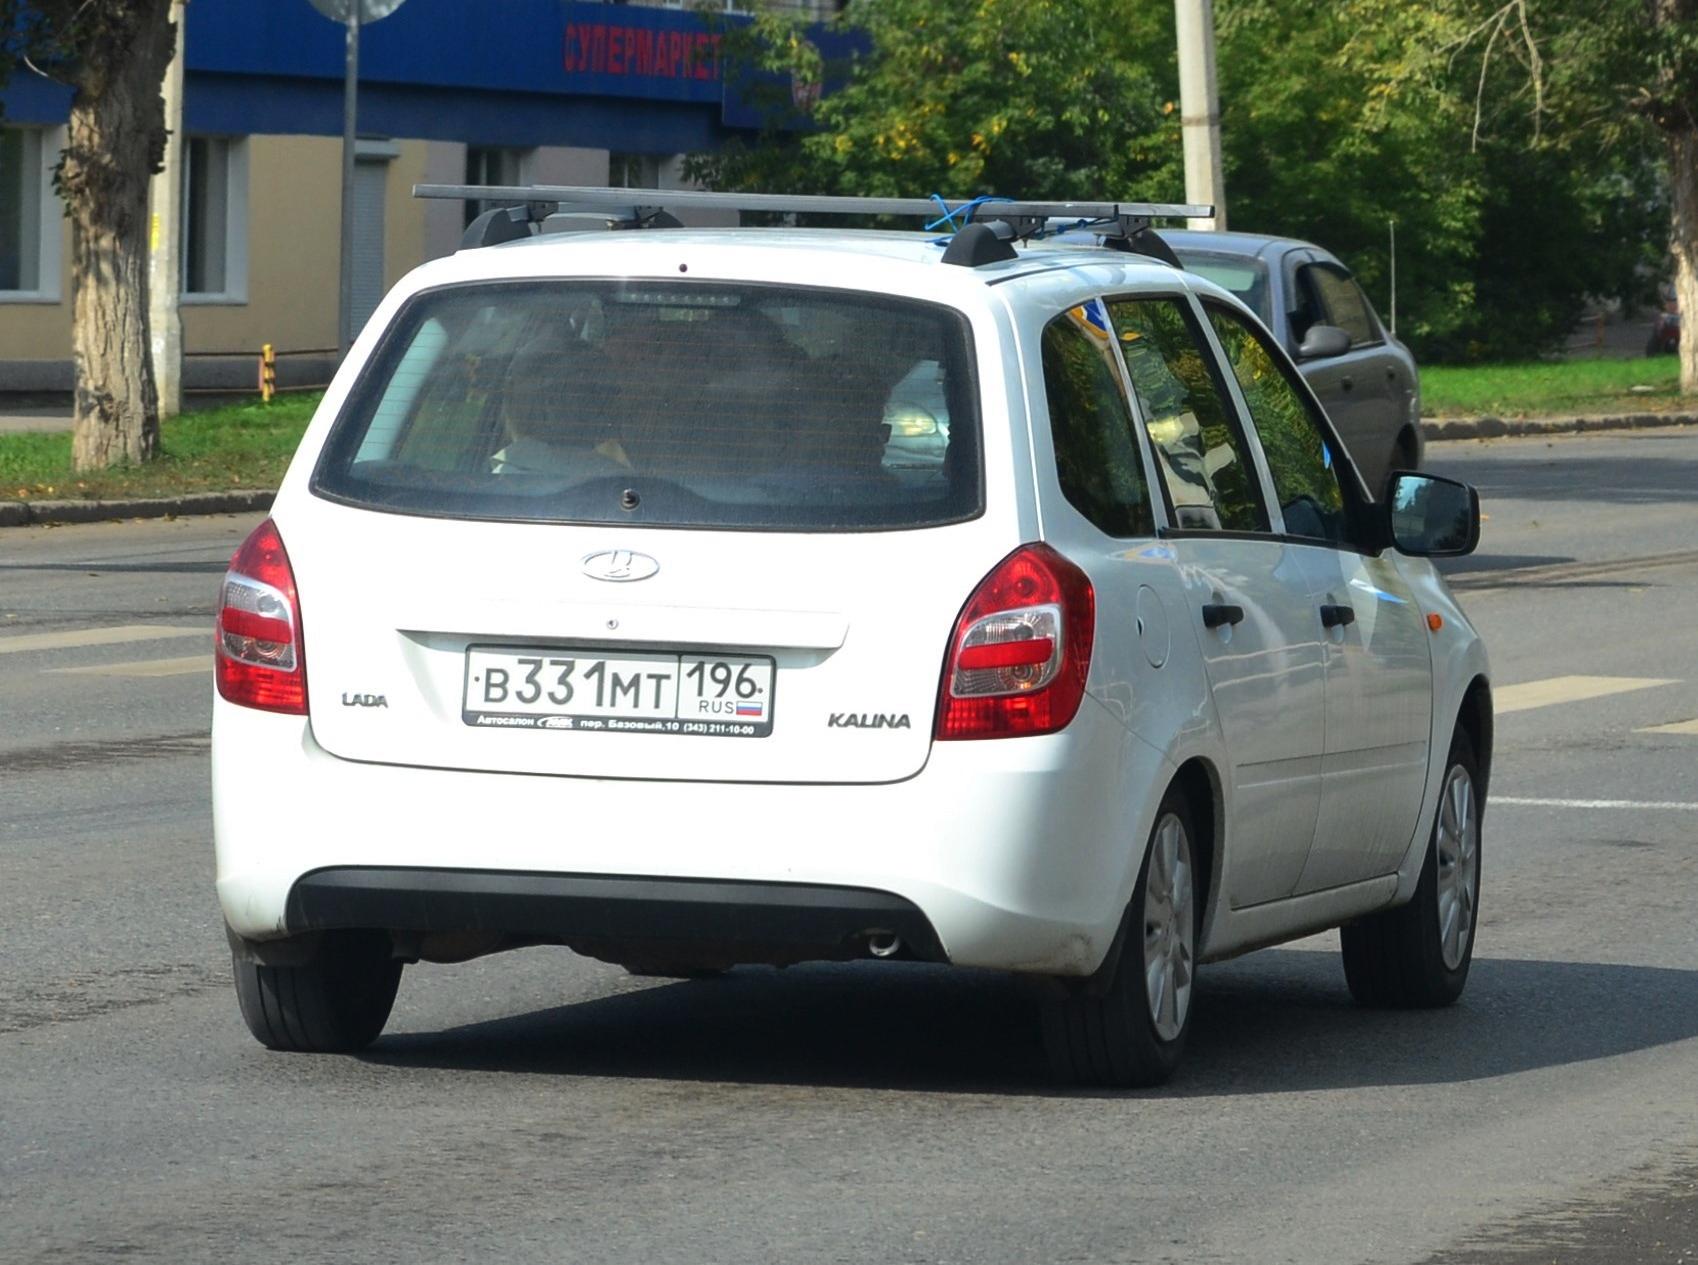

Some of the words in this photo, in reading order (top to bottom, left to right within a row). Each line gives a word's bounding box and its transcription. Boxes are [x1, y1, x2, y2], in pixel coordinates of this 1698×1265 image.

[564, 23, 722, 80] СУПЕРМАРКЕТ
[686, 661, 757, 699] 196
[342, 692, 388, 709] LADA
[699, 700, 734, 714] RUS
[477, 714, 534, 726] Автосалон
[580, 720, 606, 730] пер.
[683, 722, 708, 734] (343)
[708, 723, 755, 735] 211-10-00
[828, 713, 911, 729] KALINA
